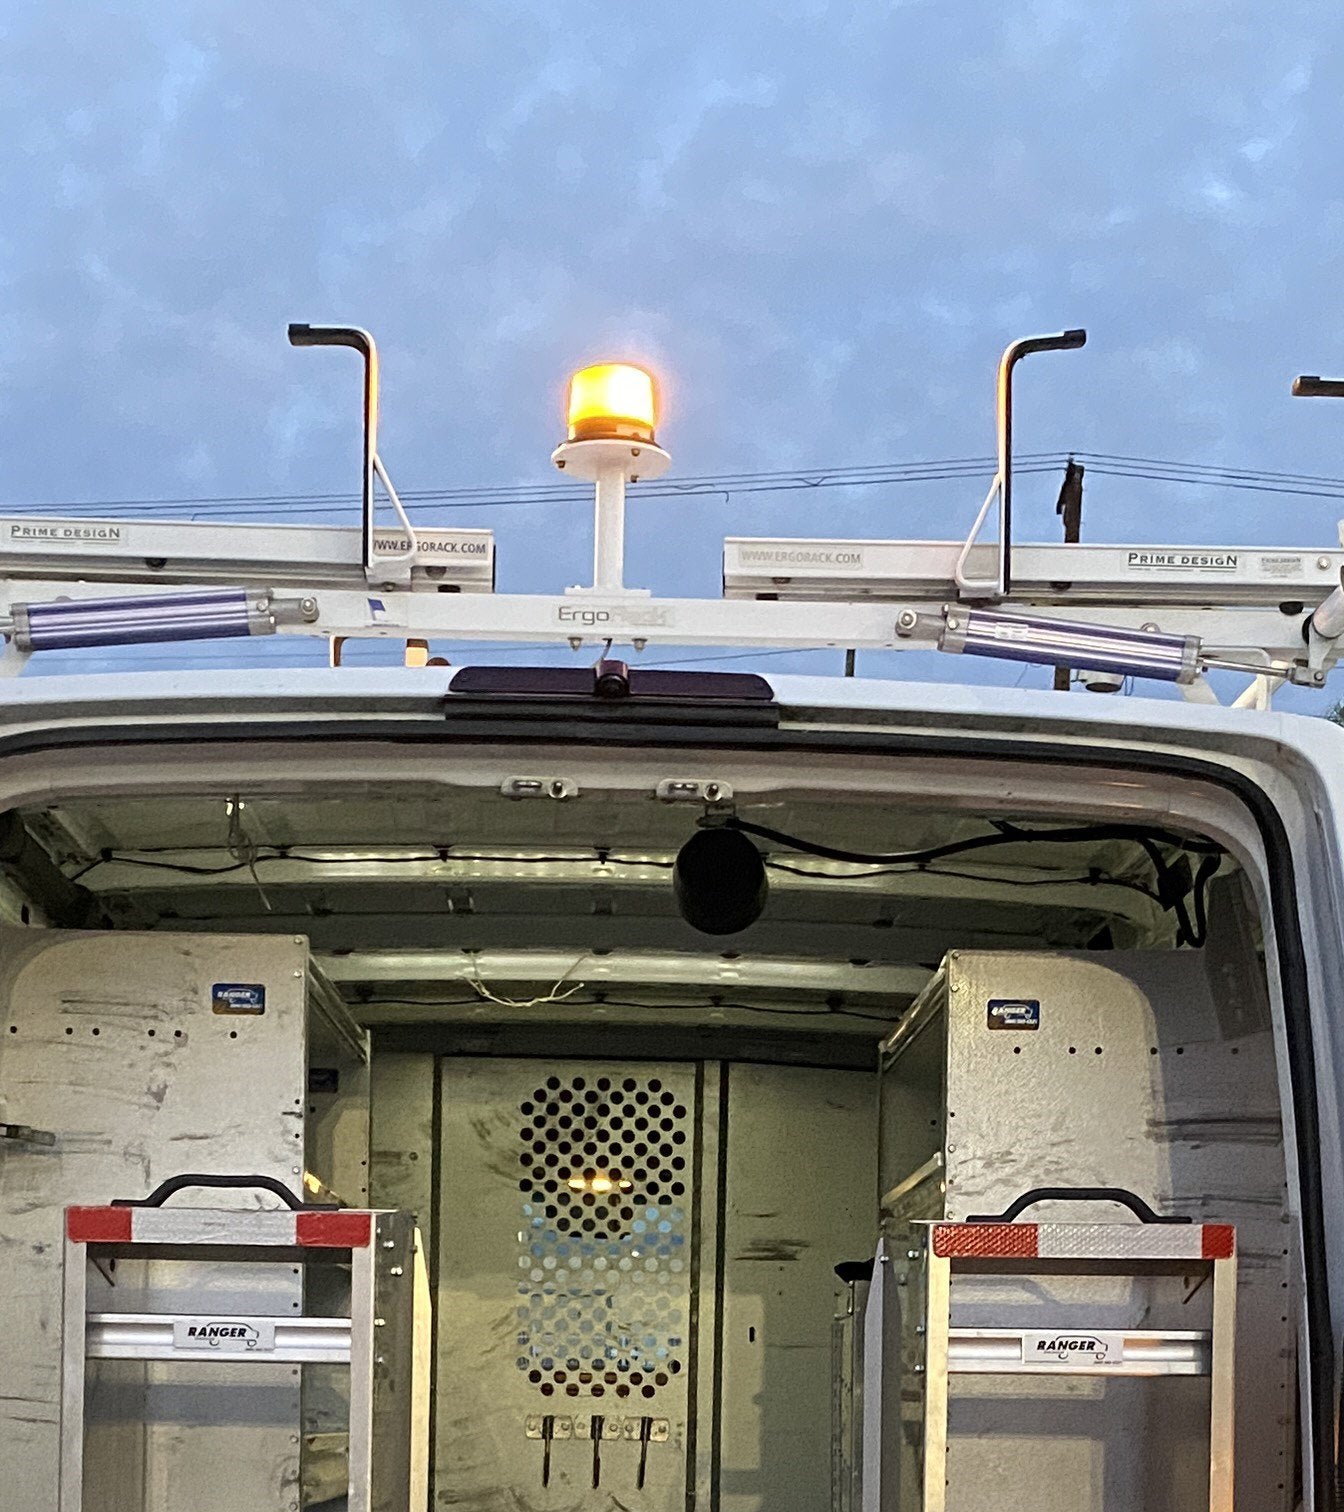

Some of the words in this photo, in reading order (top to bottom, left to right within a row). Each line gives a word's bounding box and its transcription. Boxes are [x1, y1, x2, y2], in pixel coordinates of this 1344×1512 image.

[11, 525, 57, 537] PRIME
[63, 527, 120, 538] DESIGN
[1128, 552, 1175, 565] PRIME
[1181, 555, 1238, 566] DESIGN
[188, 1327, 247, 1338] RANGER
[1037, 1340, 1096, 1351] RANGER
